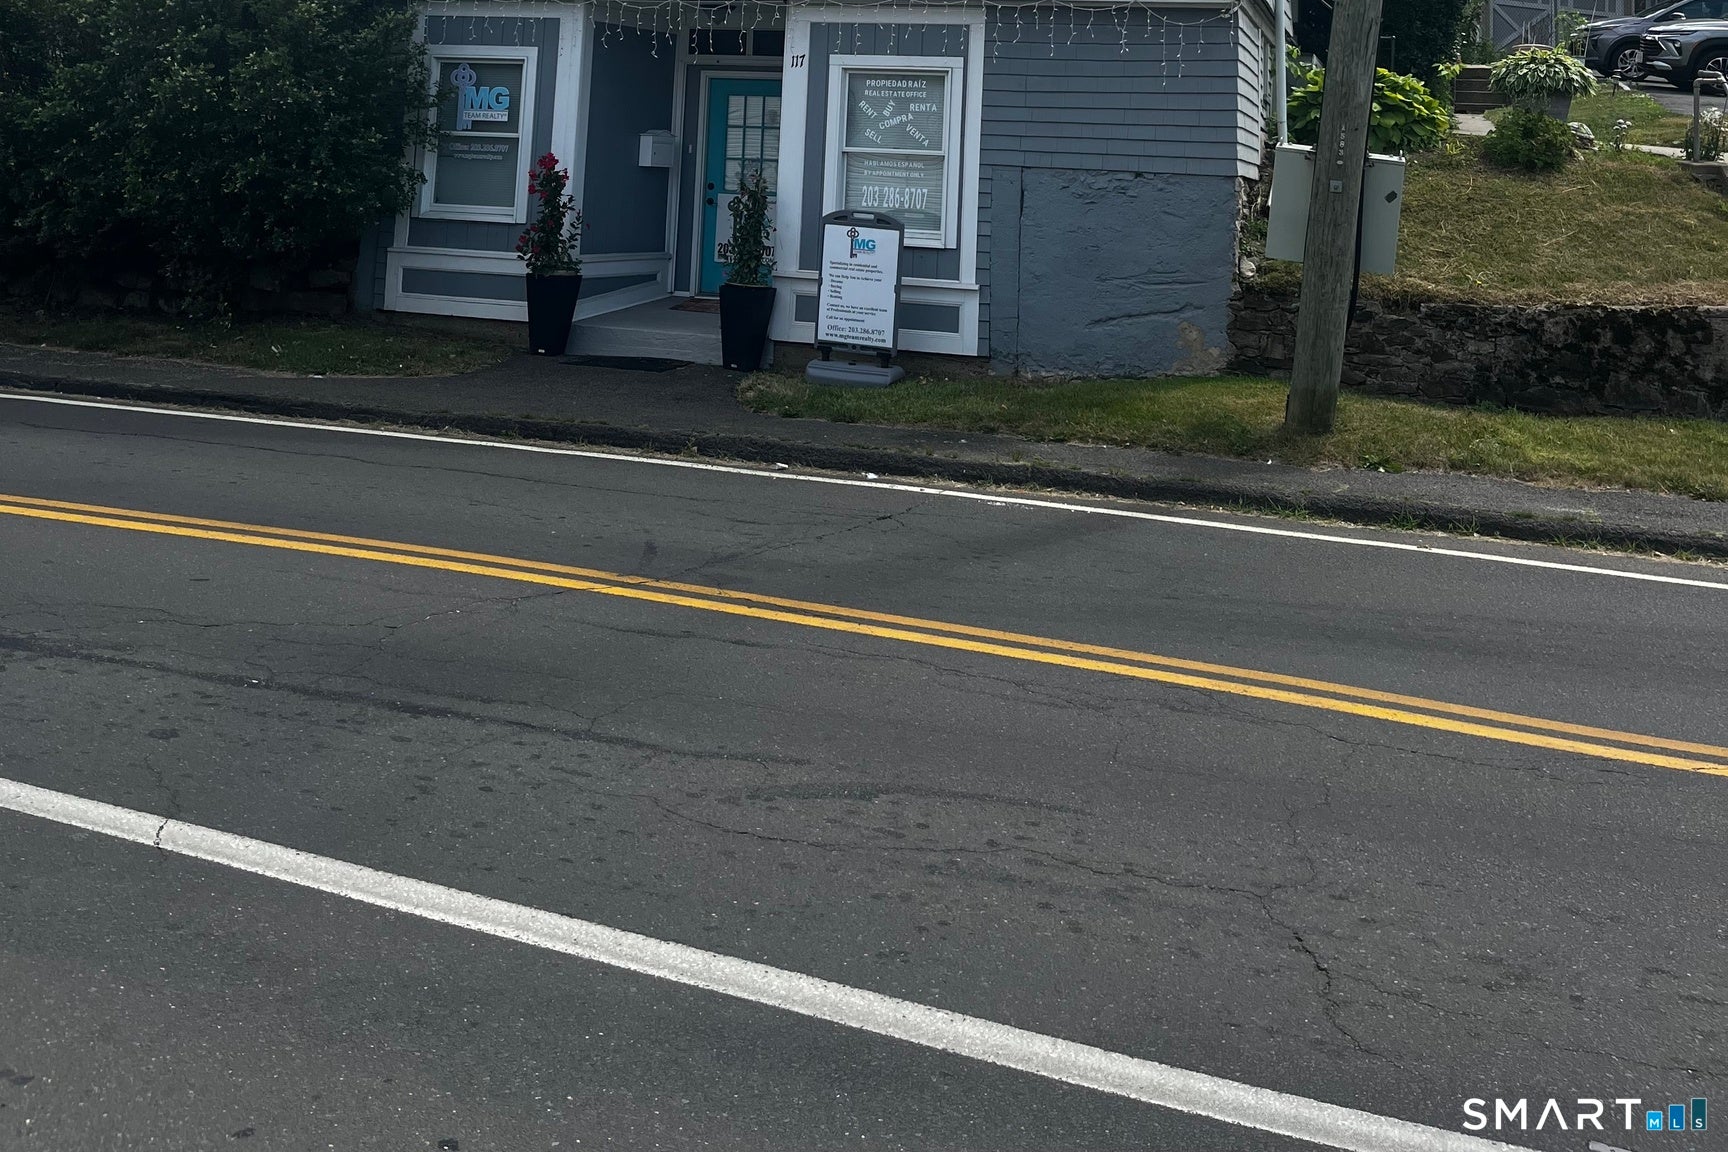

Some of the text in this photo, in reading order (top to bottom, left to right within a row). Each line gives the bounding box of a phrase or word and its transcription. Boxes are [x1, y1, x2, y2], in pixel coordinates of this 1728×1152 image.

[791, 54, 806, 68] 117
[866, 79, 926, 88] PROPIEDAD RAÍZ
[465, 86, 510, 111] MG
[865, 89, 880, 97] REAL
[881, 90, 905, 98] ESTATE
[858, 100, 878, 119] RENT
[882, 99, 896, 117] BUY
[909, 103, 938, 112] RENTA
[878, 112, 914, 130] COMPRA
[864, 128, 882, 144] SELL
[905, 123, 930, 147] VENTA
[861, 185, 928, 210] 203 286-8707
[854, 239, 876, 250] MG
[827, 324, 847, 332] Office:
